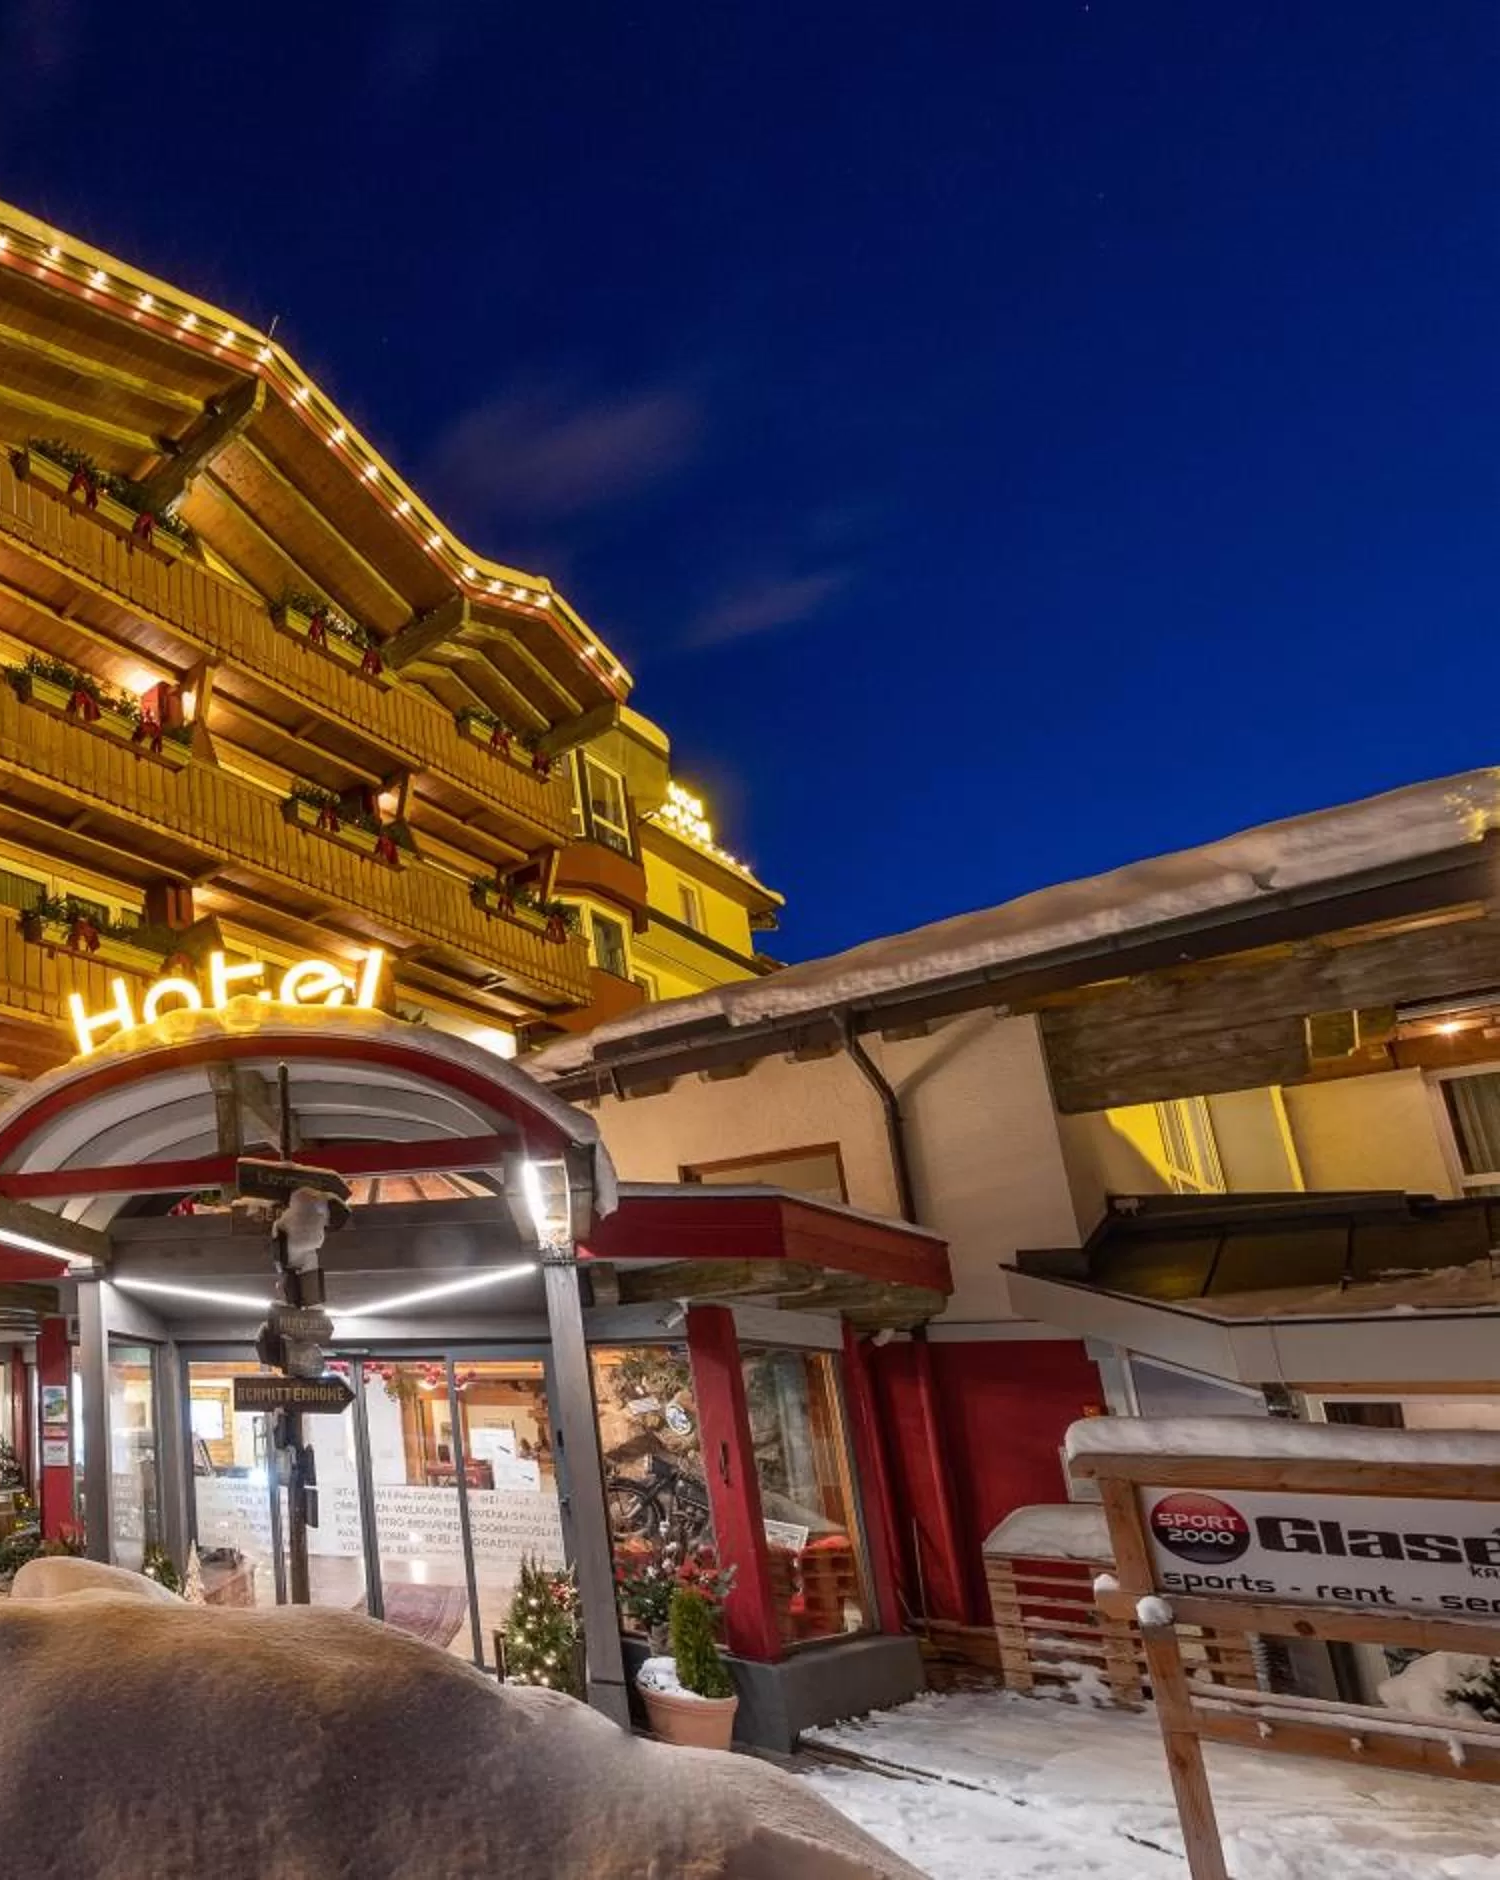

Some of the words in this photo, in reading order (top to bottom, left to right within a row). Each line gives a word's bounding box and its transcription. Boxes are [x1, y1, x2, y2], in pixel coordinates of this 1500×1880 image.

[68, 947, 385, 1055] Hotel
[1158, 1513, 1238, 1530] SPORT
[1167, 1528, 1235, 1545] 2000
[1163, 1572, 1276, 1593] sports
[1316, 1584, 1396, 1605] rent
